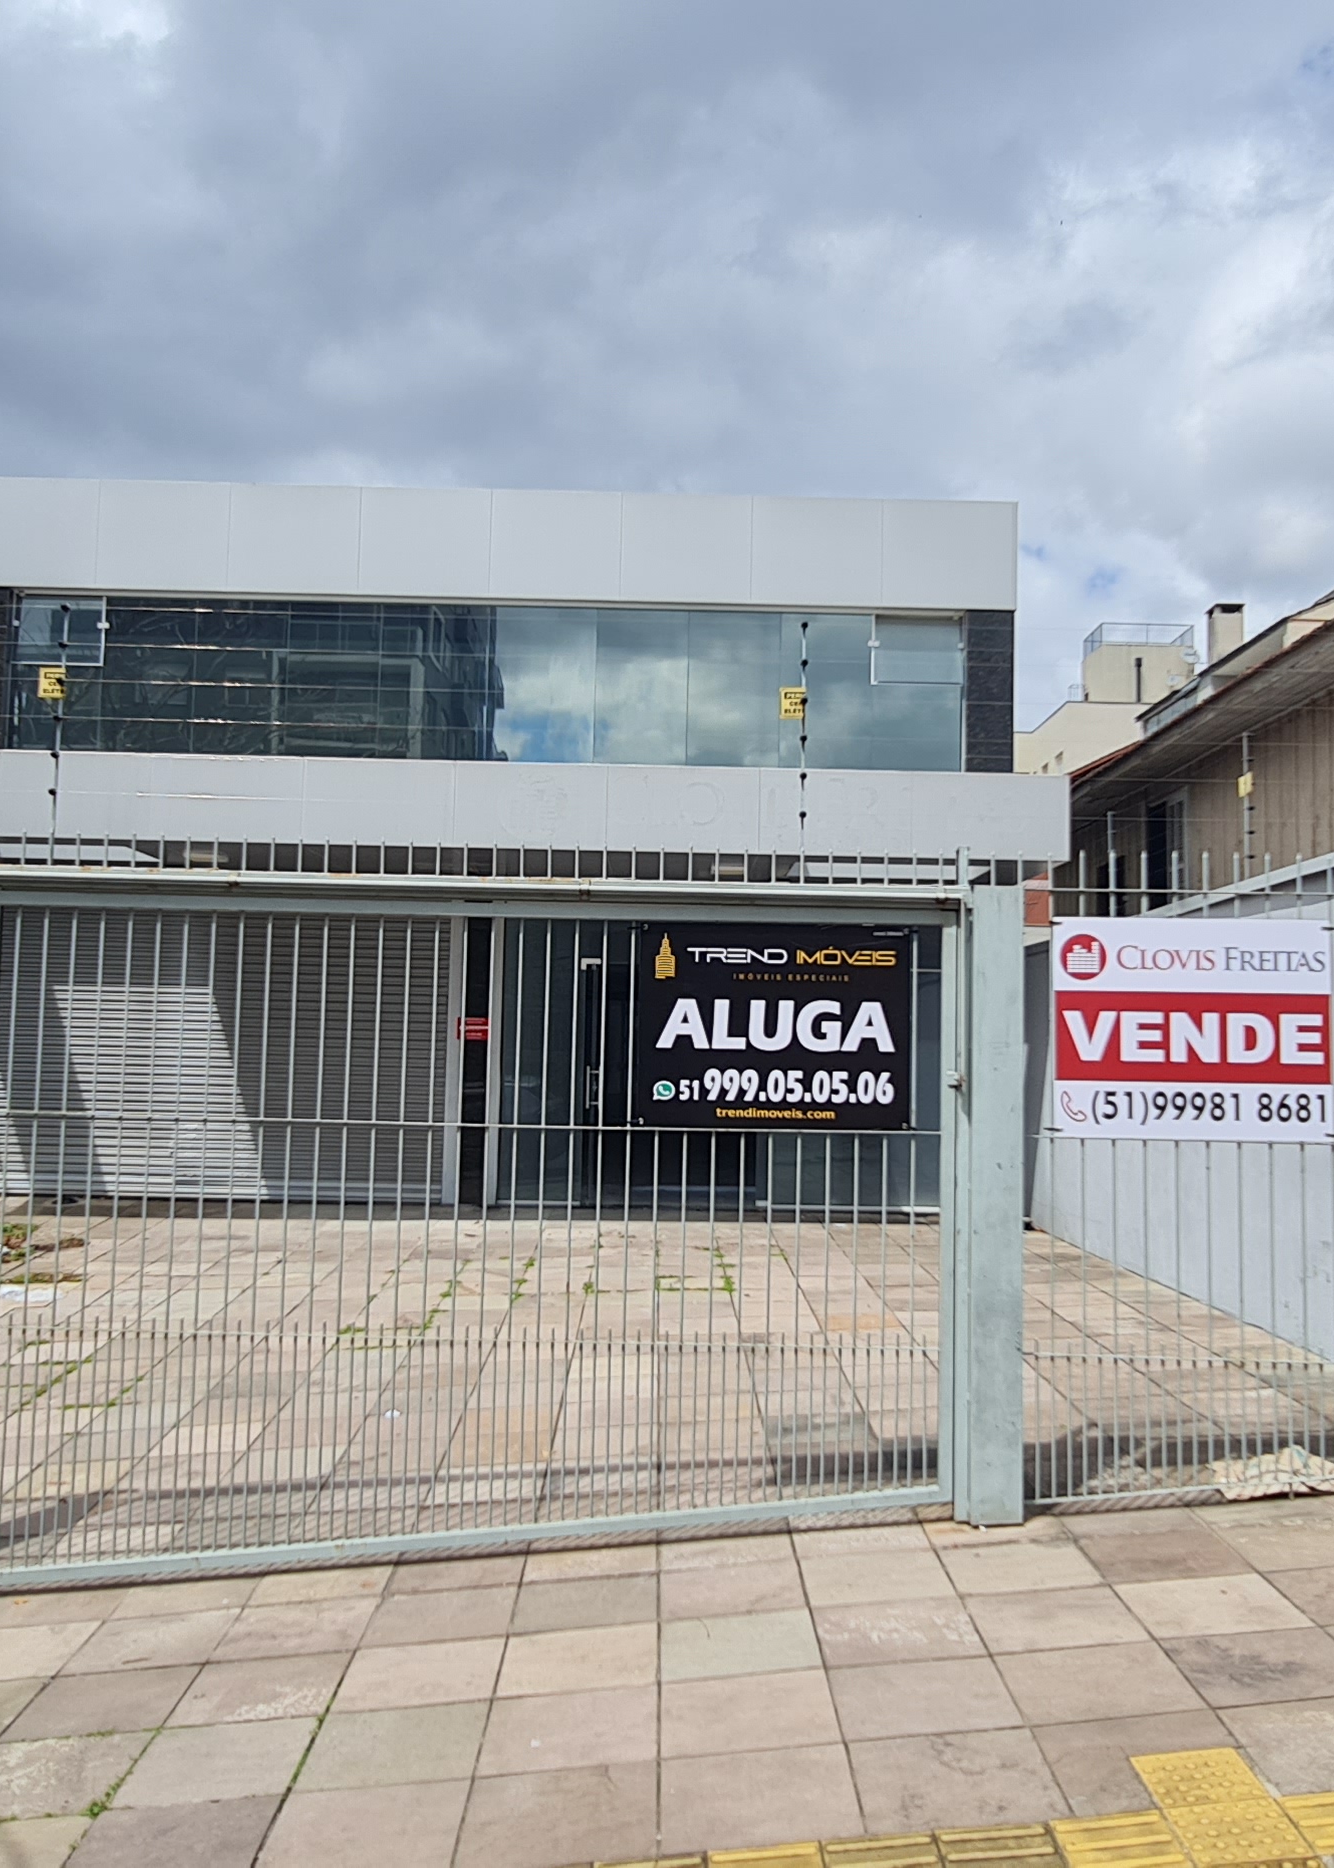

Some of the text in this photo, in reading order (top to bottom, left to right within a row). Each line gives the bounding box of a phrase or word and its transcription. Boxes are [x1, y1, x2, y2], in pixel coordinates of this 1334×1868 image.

[686, 946, 897, 967] TREND IMÓVEIS
[1117, 945, 1326, 972] CLOVIS FREITAS
[733, 972, 850, 982] IMÓVEIS ESPECIAIS
[655, 998, 896, 1052] ALUGA
[1062, 1010, 1325, 1065] VENDE
[679, 1068, 895, 1104] 51 999.05.05.06
[716, 1107, 836, 1120] trendimoveis.com
[1092, 1090, 1327, 1125] (51)99981 8681
